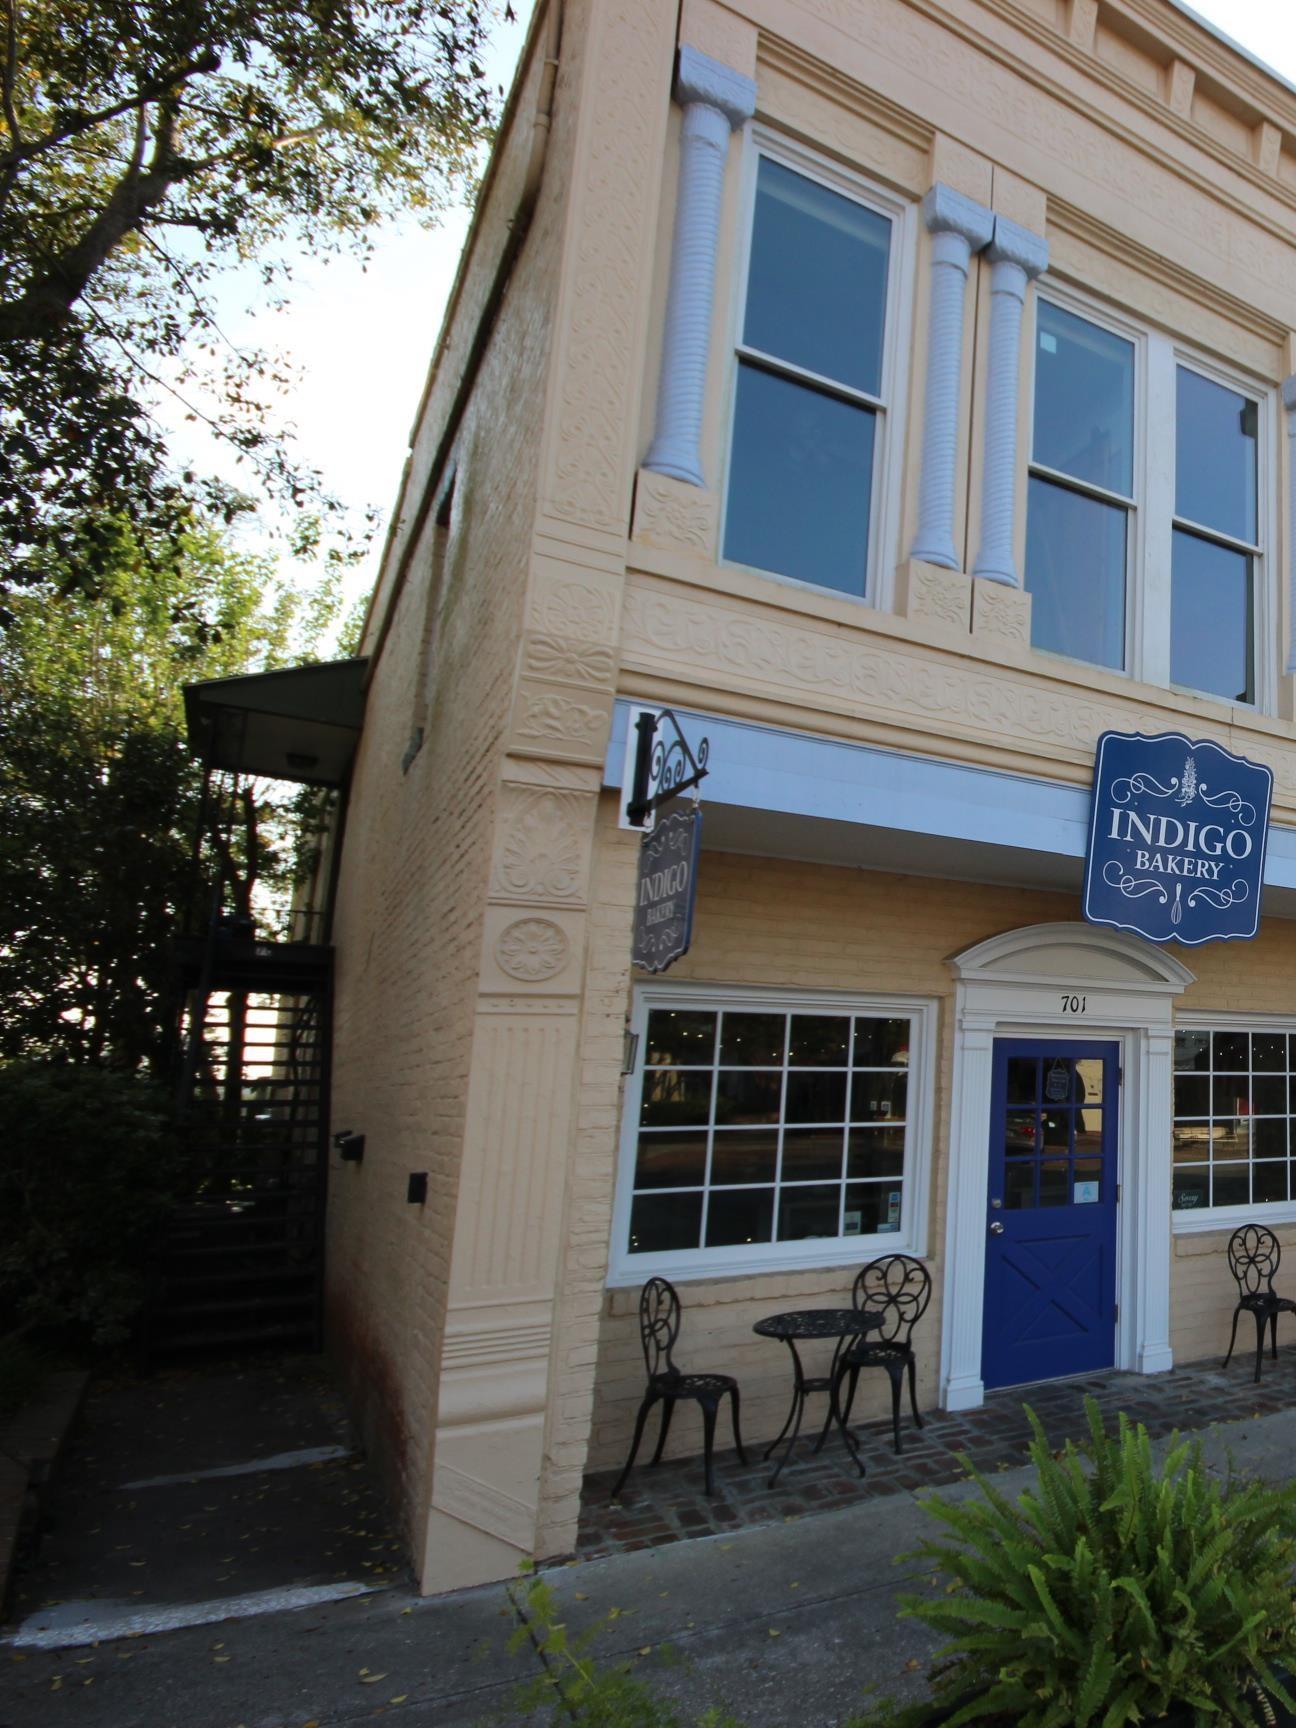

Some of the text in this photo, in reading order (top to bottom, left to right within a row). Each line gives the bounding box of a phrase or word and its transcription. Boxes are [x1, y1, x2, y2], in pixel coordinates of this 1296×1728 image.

[1107, 807, 1252, 860] INDIGO
[639, 861, 688, 906] INDIGO
[1135, 850, 1225, 881] BAKERY
[1061, 995, 1086, 1013] 701
